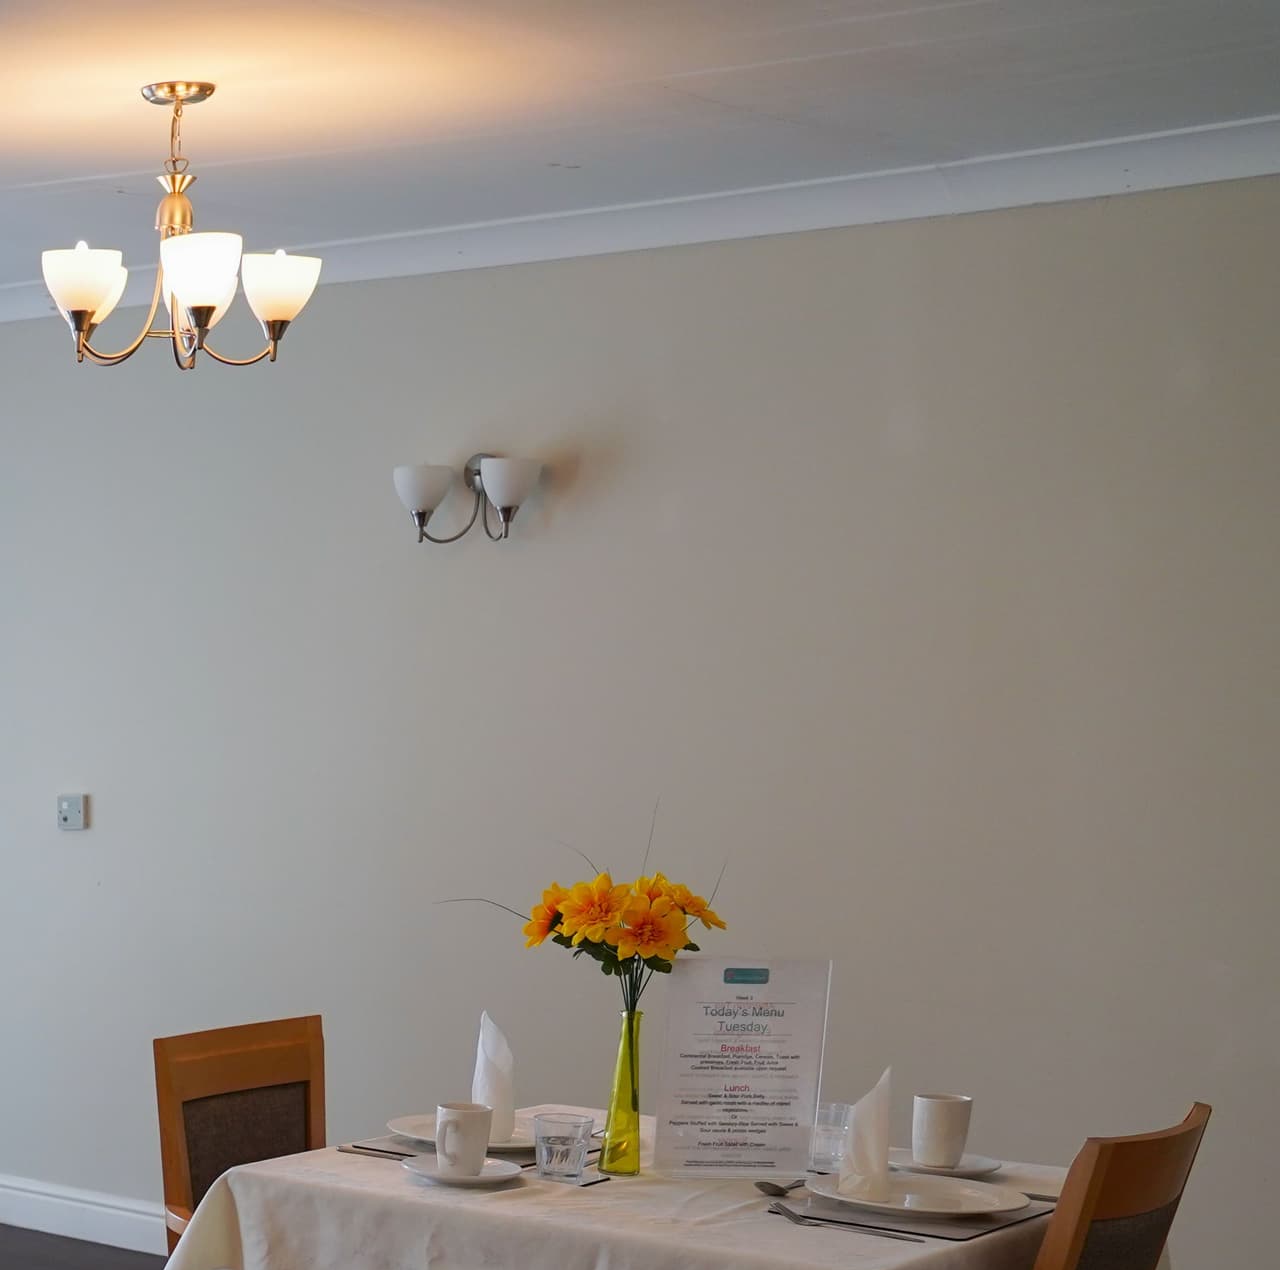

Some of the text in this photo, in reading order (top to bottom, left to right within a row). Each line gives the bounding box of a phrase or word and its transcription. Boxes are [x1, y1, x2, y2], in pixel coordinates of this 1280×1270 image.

[703, 1006, 785, 1019] Today's Menu
[717, 1020, 768, 1034] Tuesday
[720, 1044, 761, 1053] Breakfast
[724, 1084, 750, 1092] Lunch
